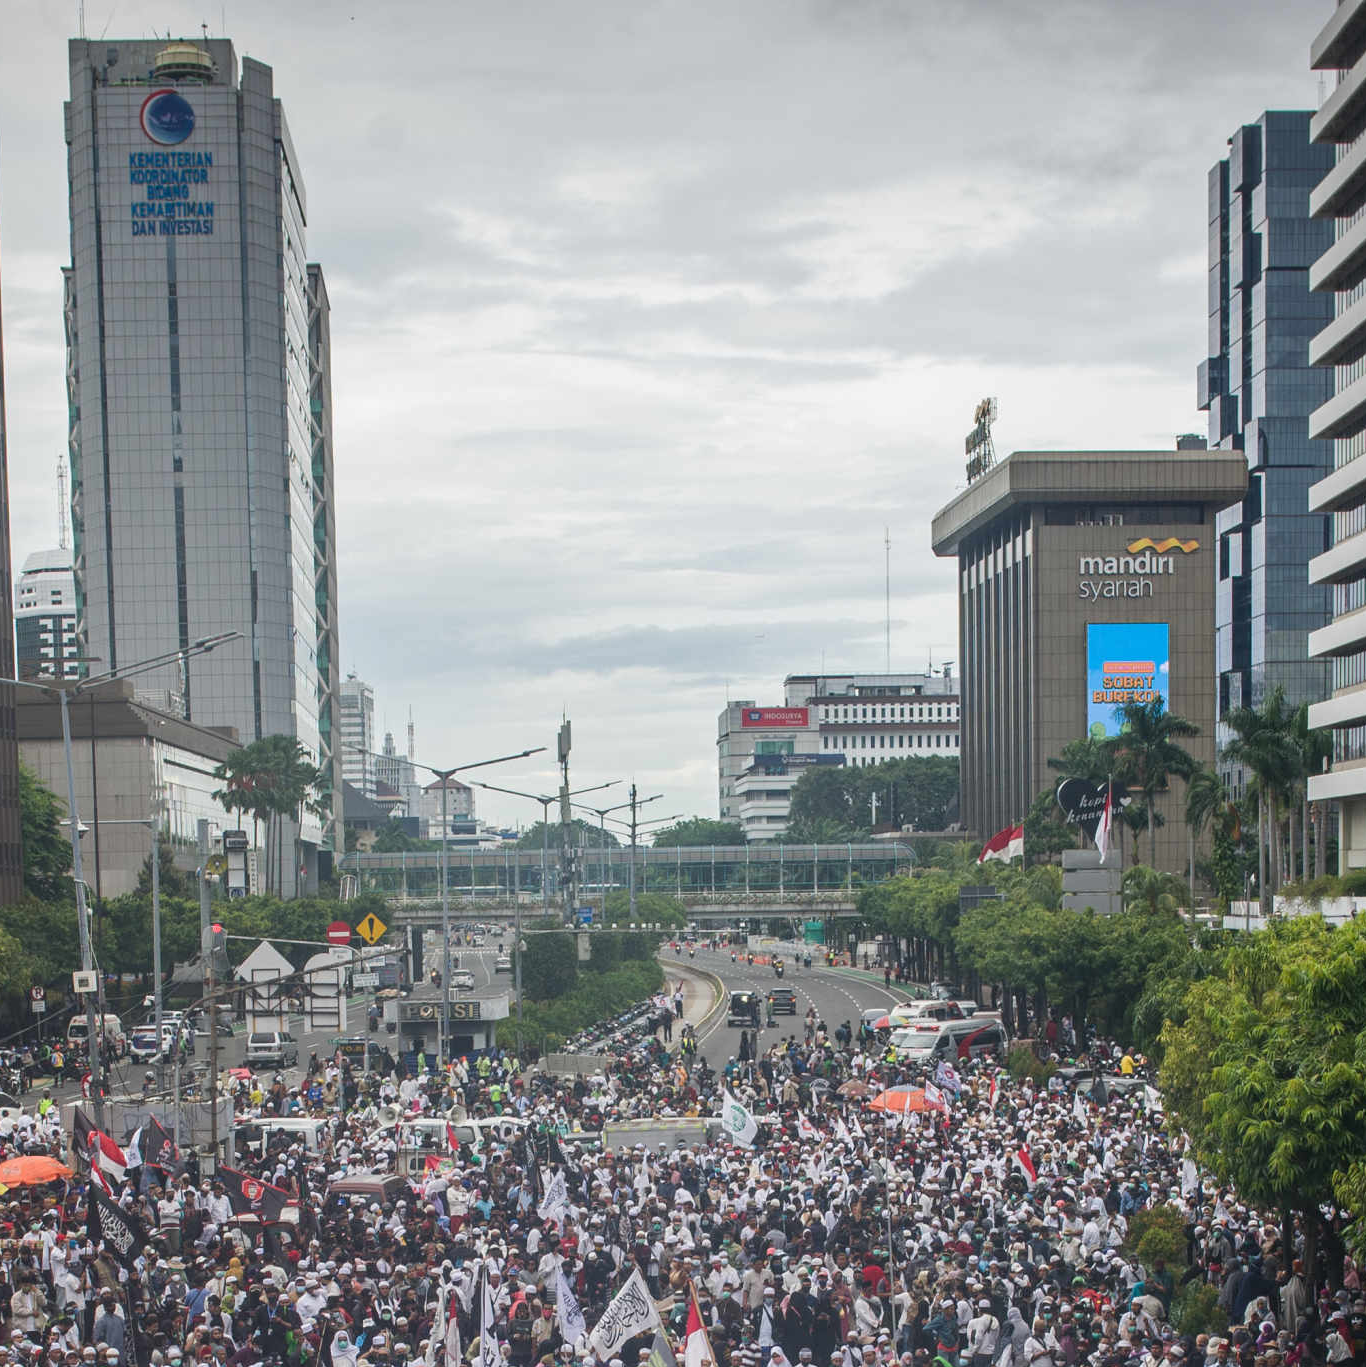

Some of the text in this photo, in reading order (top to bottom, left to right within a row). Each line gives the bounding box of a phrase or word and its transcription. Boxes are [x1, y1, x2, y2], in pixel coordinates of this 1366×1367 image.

[129, 152, 213, 168] KEMENTERIAN
[130, 168, 209, 184] KOORDINATOR
[146, 185, 189, 200] BIDANG
[131, 202, 214, 218] KEMARITIMAN
[132, 220, 214, 236] DAN INVESTASI
[1079, 551, 1174, 574] mandiri
[1079, 577, 1154, 602] syariah
[1103, 676, 1154, 689] SOBAT
